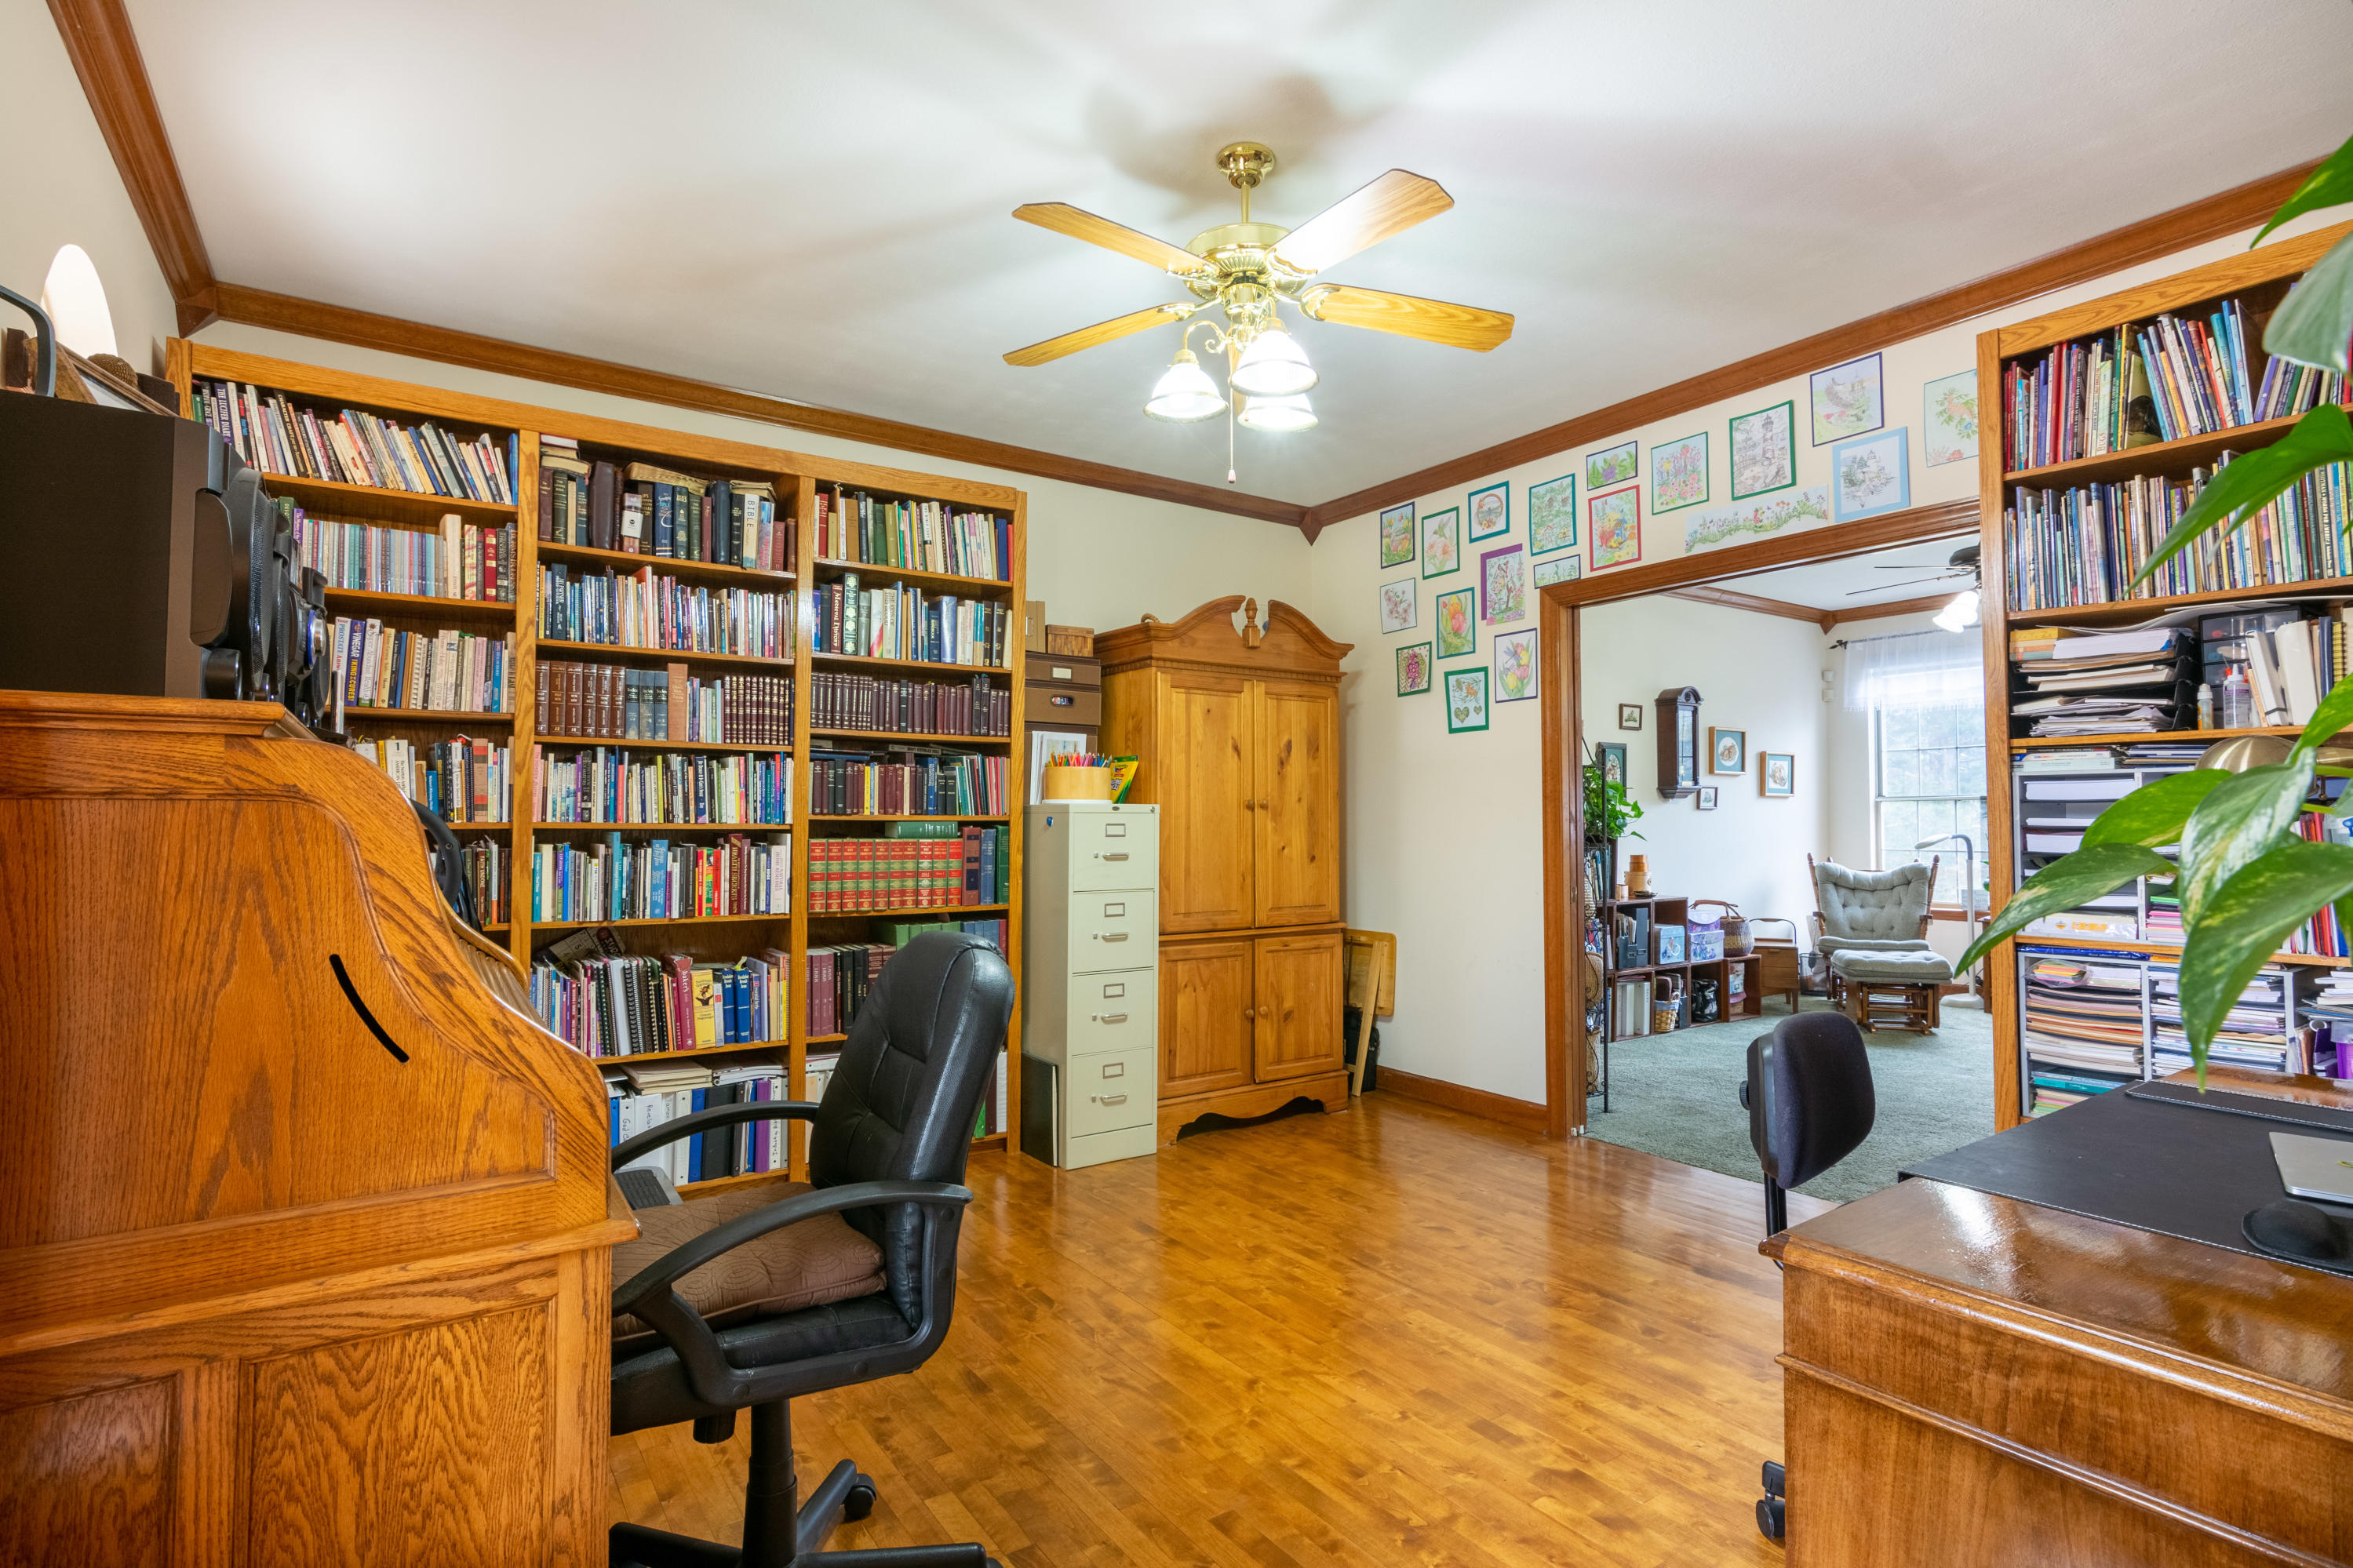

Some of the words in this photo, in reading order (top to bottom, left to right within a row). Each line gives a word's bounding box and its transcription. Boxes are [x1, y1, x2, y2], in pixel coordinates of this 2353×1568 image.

[219, 400, 229, 420] LUCIFER
[278, 395, 290, 422] CHARACTER
[222, 422, 231, 437] DIARY
[2097, 433, 2106, 452] BUGS
[412, 453, 421, 464] Again
[351, 632, 361, 657] VINEGAR
